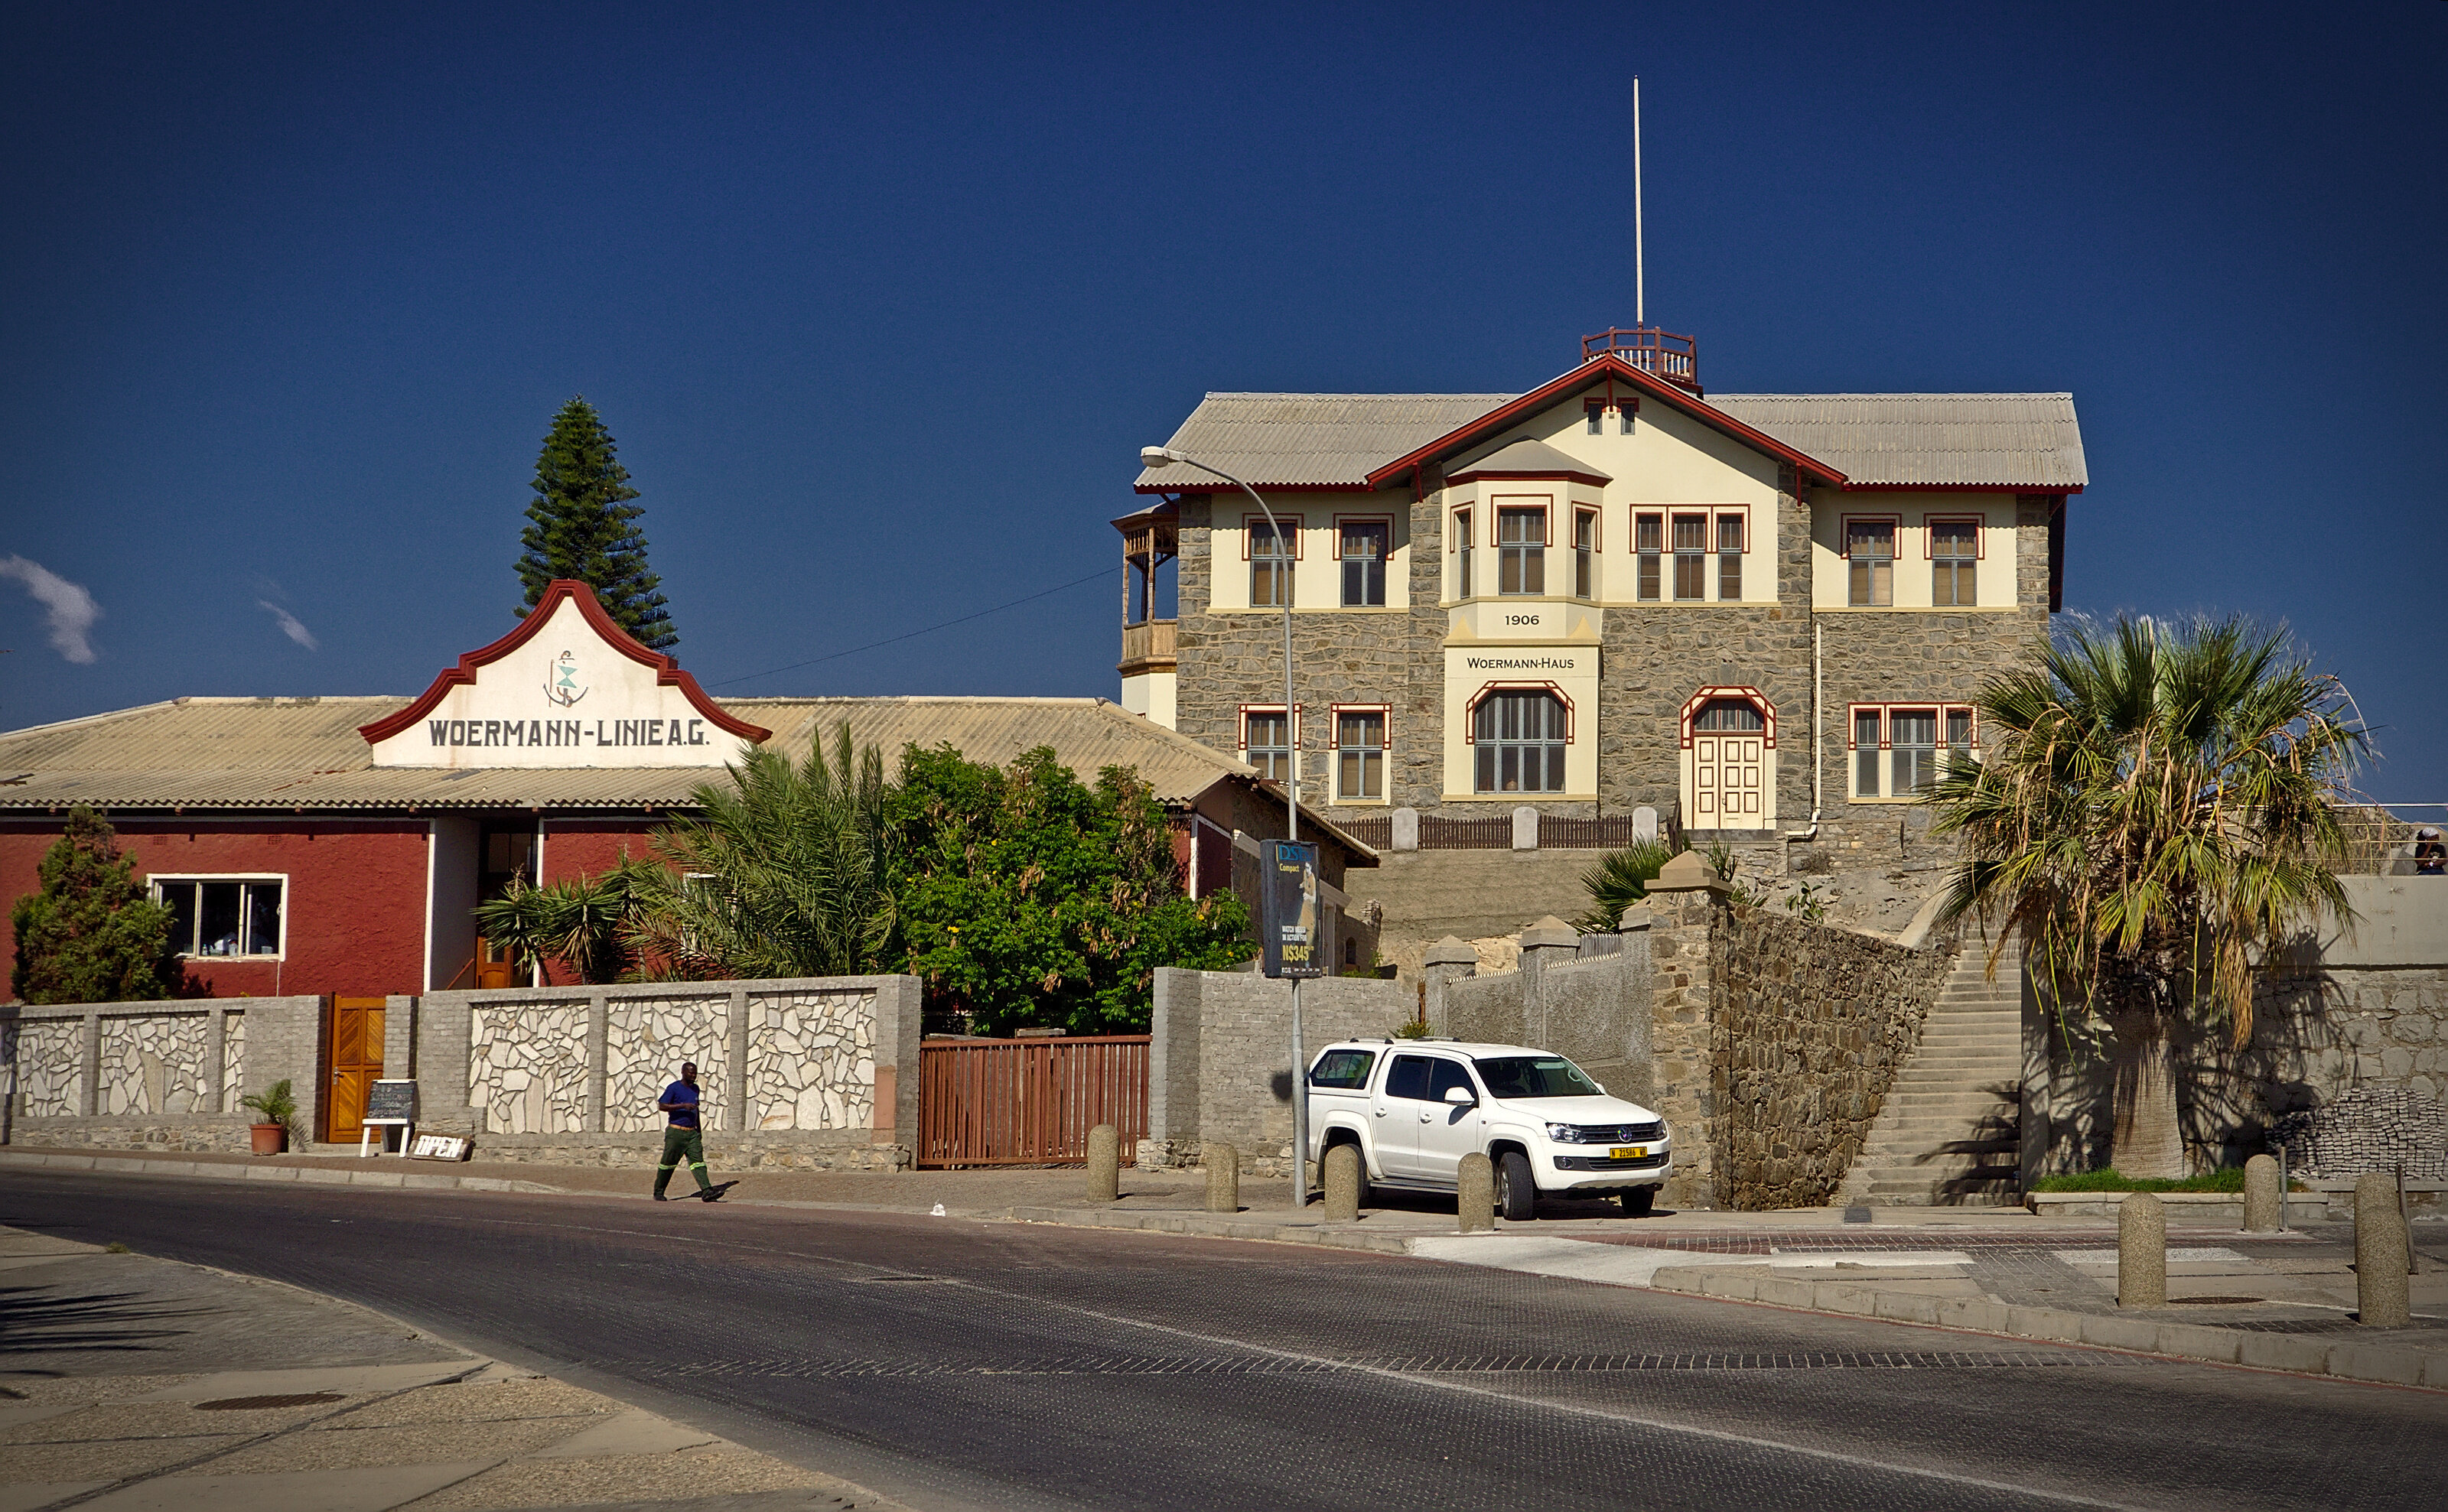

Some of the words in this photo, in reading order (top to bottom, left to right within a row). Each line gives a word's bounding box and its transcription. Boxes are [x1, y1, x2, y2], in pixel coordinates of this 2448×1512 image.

[1505, 615, 1540, 626] 1906
[1467, 657, 1574, 669] WOERMANN-HAUS
[428, 719, 663, 746] WOERMANN-LINIE
[667, 719, 710, 746] A.G.
[1279, 863, 1300, 873] Compact
[414, 1135, 464, 1158] OPEN
